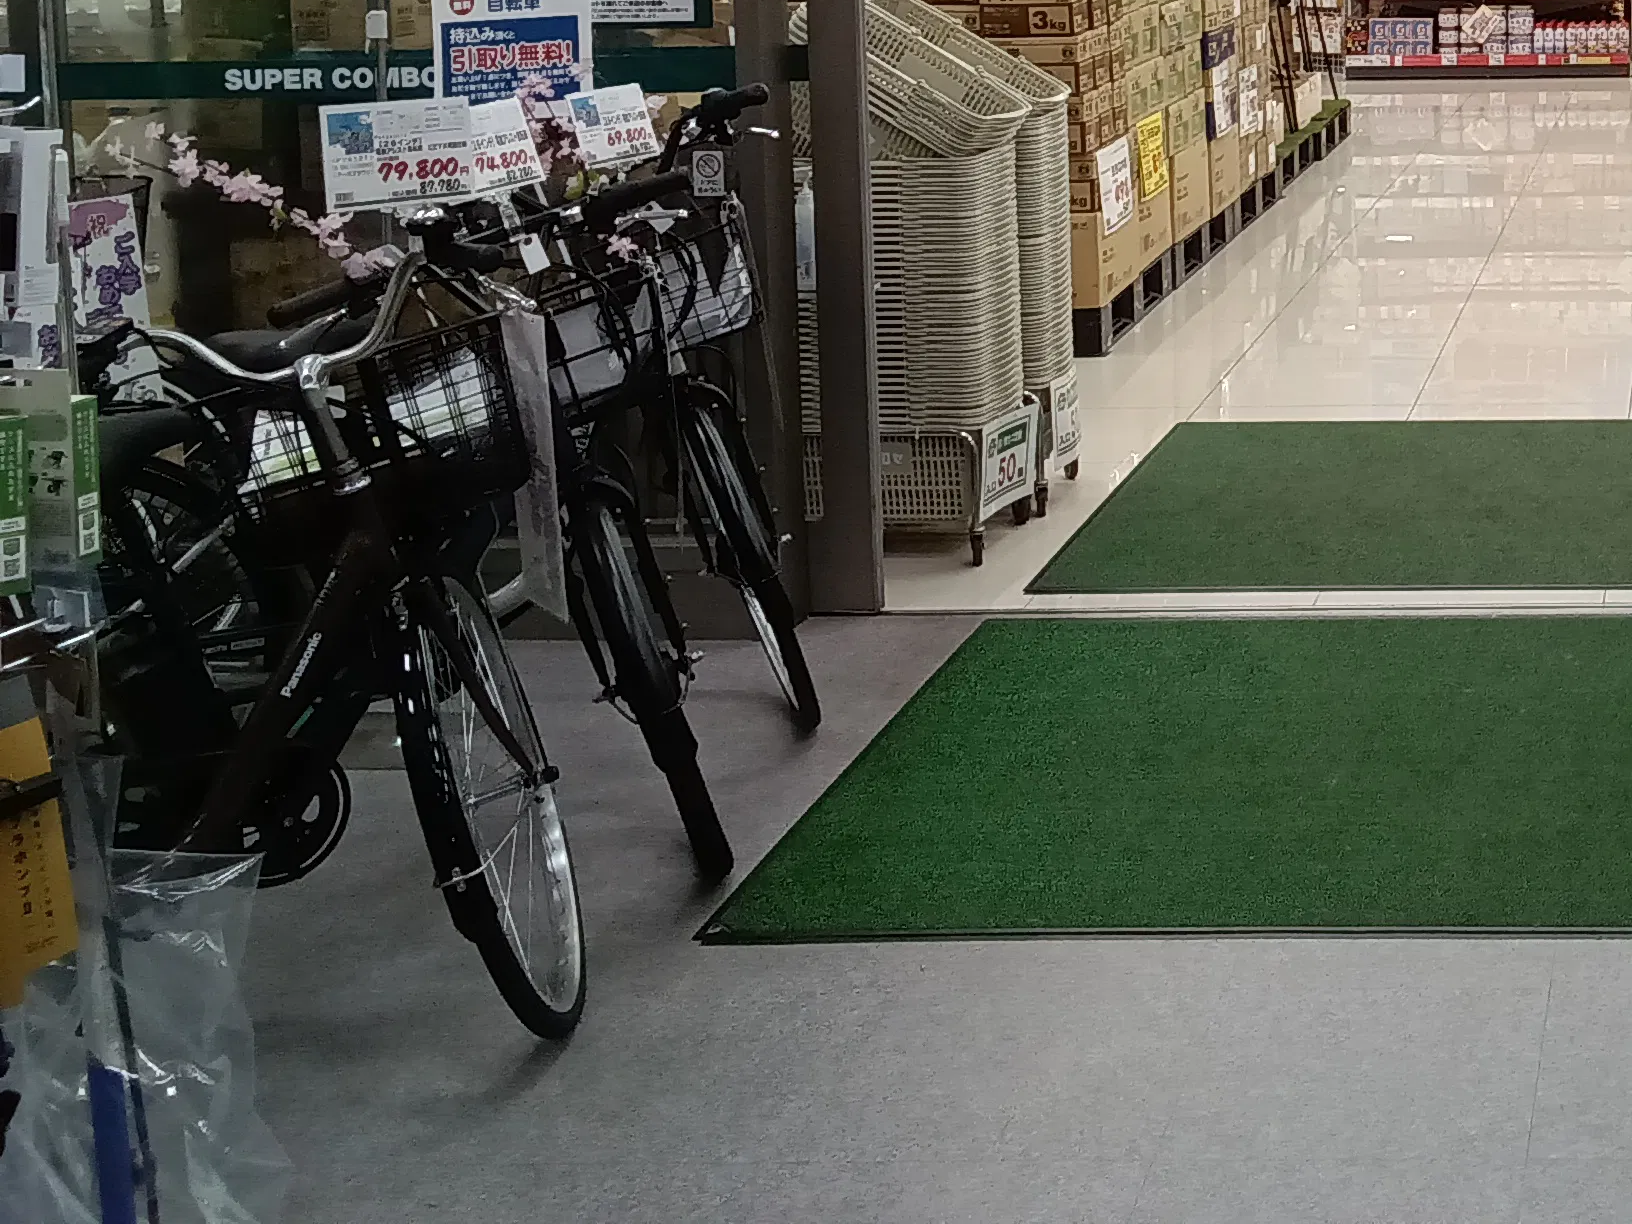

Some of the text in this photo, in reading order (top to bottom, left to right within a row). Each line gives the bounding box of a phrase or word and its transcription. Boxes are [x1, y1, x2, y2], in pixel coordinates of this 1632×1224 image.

[1033, 10, 1066, 32] 3kg
[224, 68, 322, 91] SUPER
[86, 213, 107, 239] 祝
[280, 631, 323, 698] Panasonic
